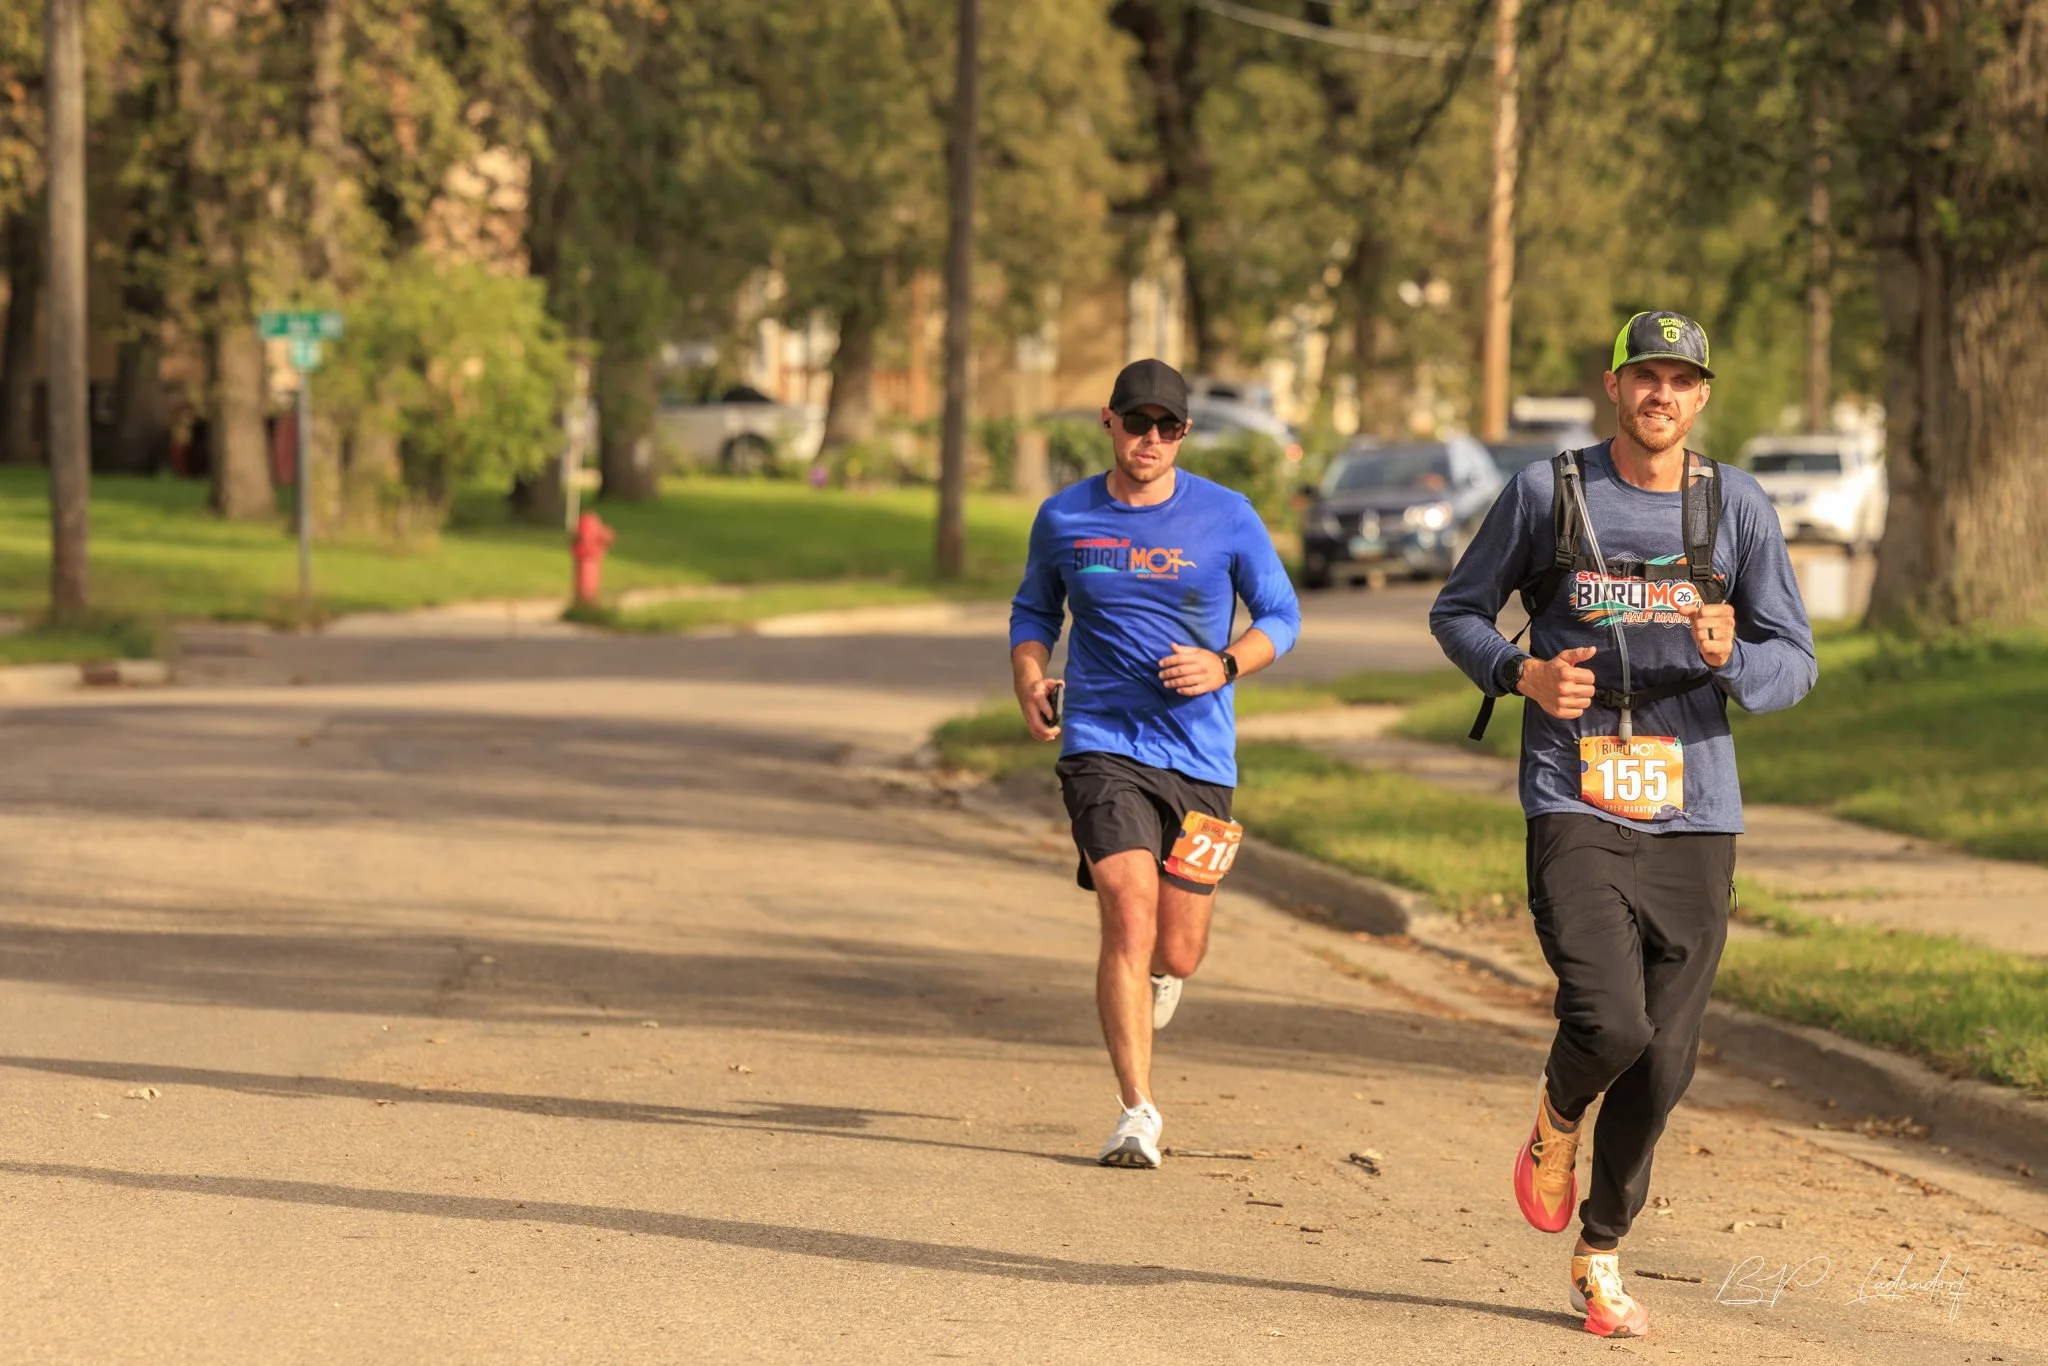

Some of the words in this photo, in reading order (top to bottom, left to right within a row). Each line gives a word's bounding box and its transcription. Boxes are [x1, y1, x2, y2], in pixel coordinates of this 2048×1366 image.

[1666, 328, 1677, 339] ds
[1074, 547, 1184, 574] BURLIMOT
[1576, 583, 1701, 610] BURLIMO
[1676, 591, 1691, 602] 26
[1622, 612, 1653, 623] HALF
[1654, 612, 1691, 624] MARA
[1602, 743, 1656, 756] BURLIMOT
[1596, 759, 1668, 802] 155
[1623, 805, 1661, 814] MARATHON
